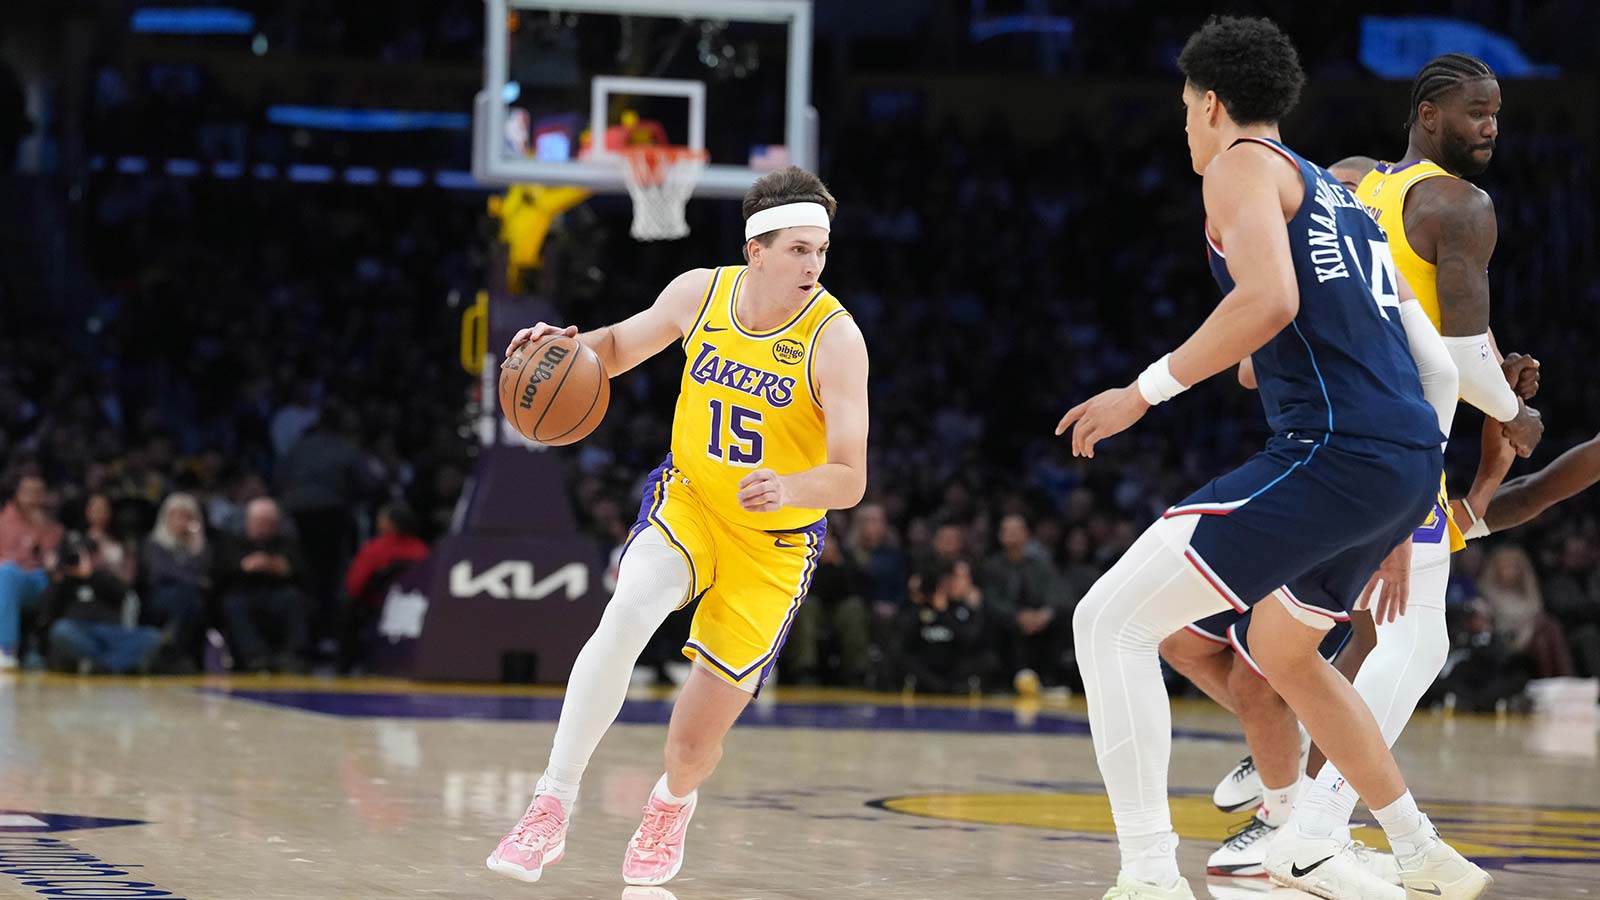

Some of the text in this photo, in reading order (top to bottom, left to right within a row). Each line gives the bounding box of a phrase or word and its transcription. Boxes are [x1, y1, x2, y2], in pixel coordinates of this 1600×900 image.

[520, 345, 571, 410] Wilson
[690, 342, 796, 408] LAKERS
[775, 343, 803, 359] bibigo
[707, 399, 763, 468] 15
